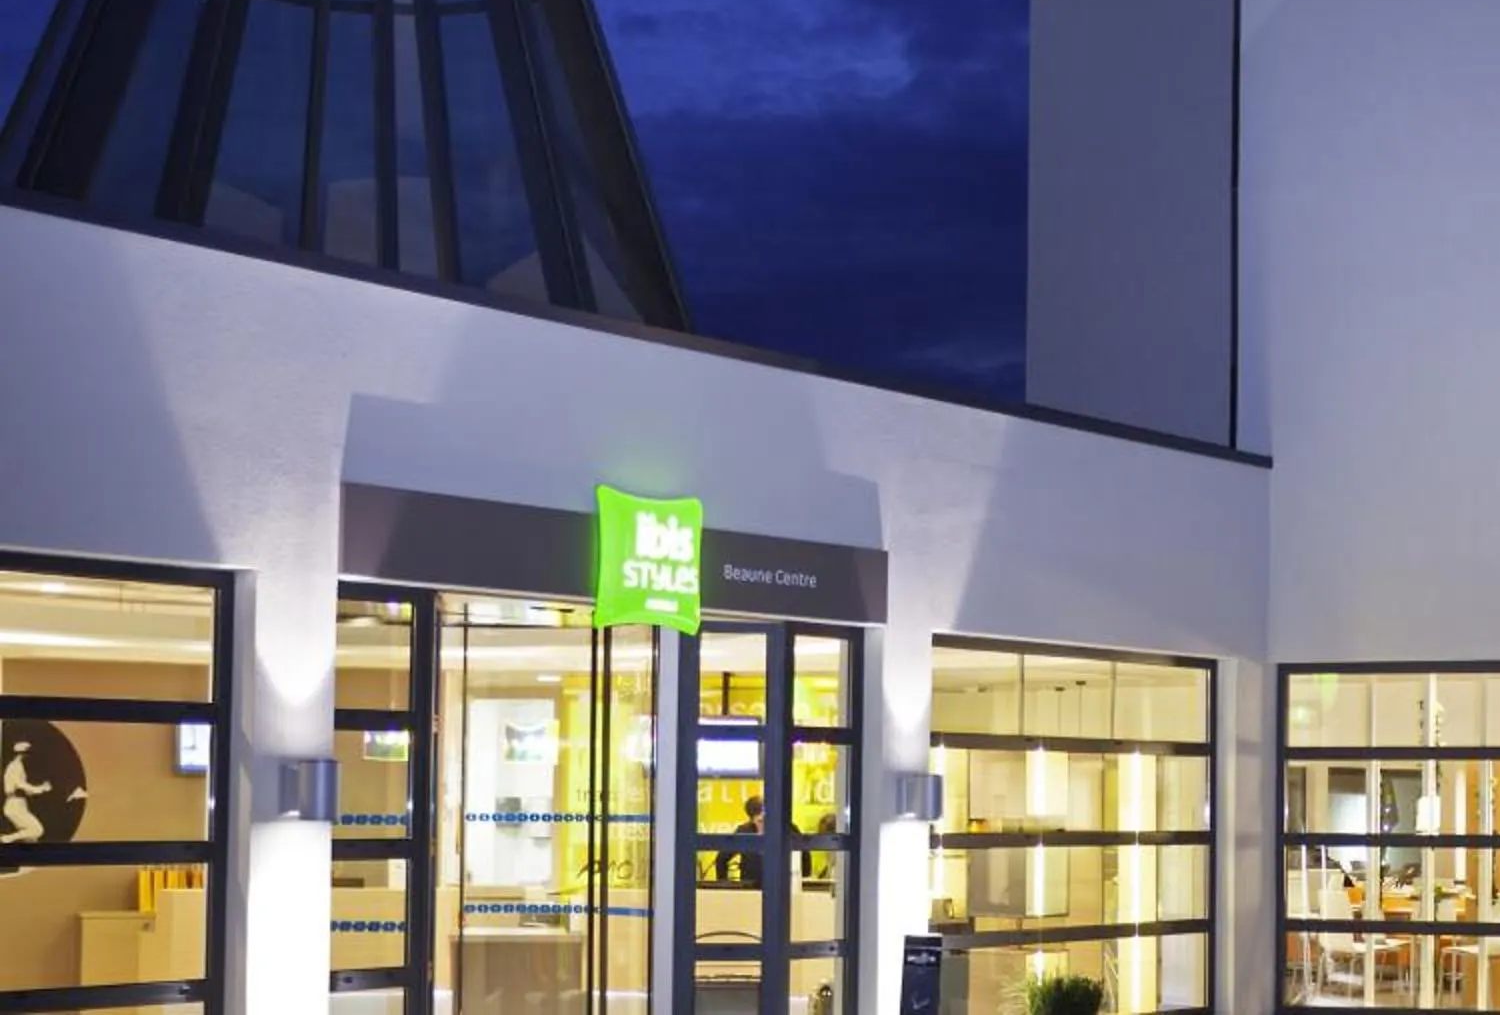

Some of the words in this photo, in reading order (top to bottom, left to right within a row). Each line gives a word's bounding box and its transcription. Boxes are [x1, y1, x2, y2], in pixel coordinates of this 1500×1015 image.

[636, 511, 694, 561] ibis
[623, 560, 698, 594] STYLES
[723, 564, 773, 584] Beaune
[775, 569, 817, 589] Centre
